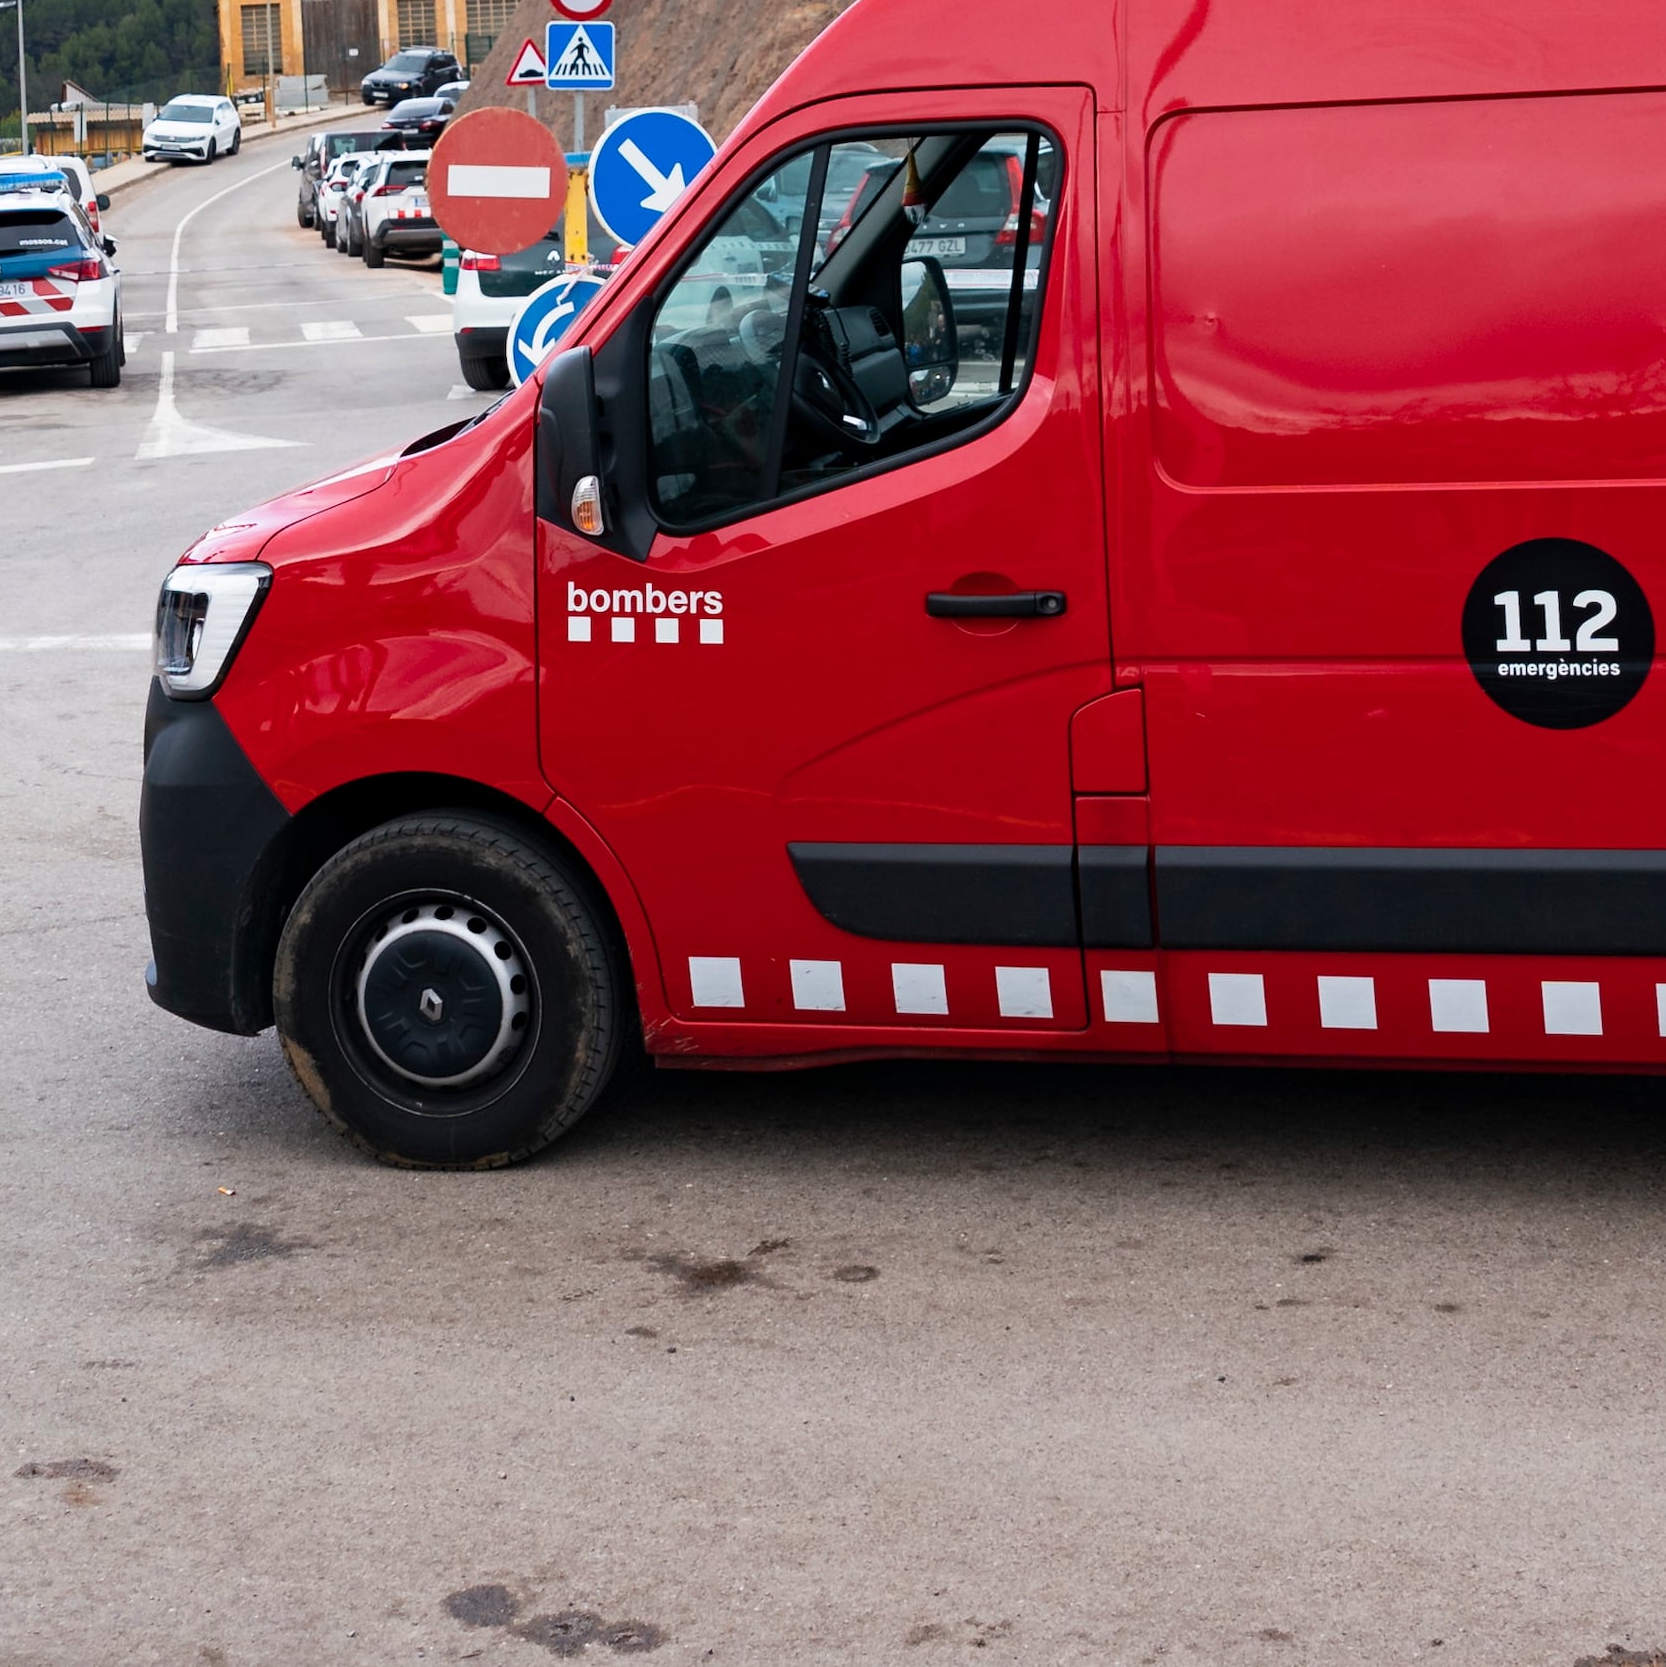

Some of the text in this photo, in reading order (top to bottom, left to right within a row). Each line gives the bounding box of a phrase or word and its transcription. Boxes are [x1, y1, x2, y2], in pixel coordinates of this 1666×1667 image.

[938, 239, 962, 253] GZL
[567, 581, 724, 615] bombers
[1494, 589, 1619, 652] 112
[1498, 659, 1621, 680] emergències
